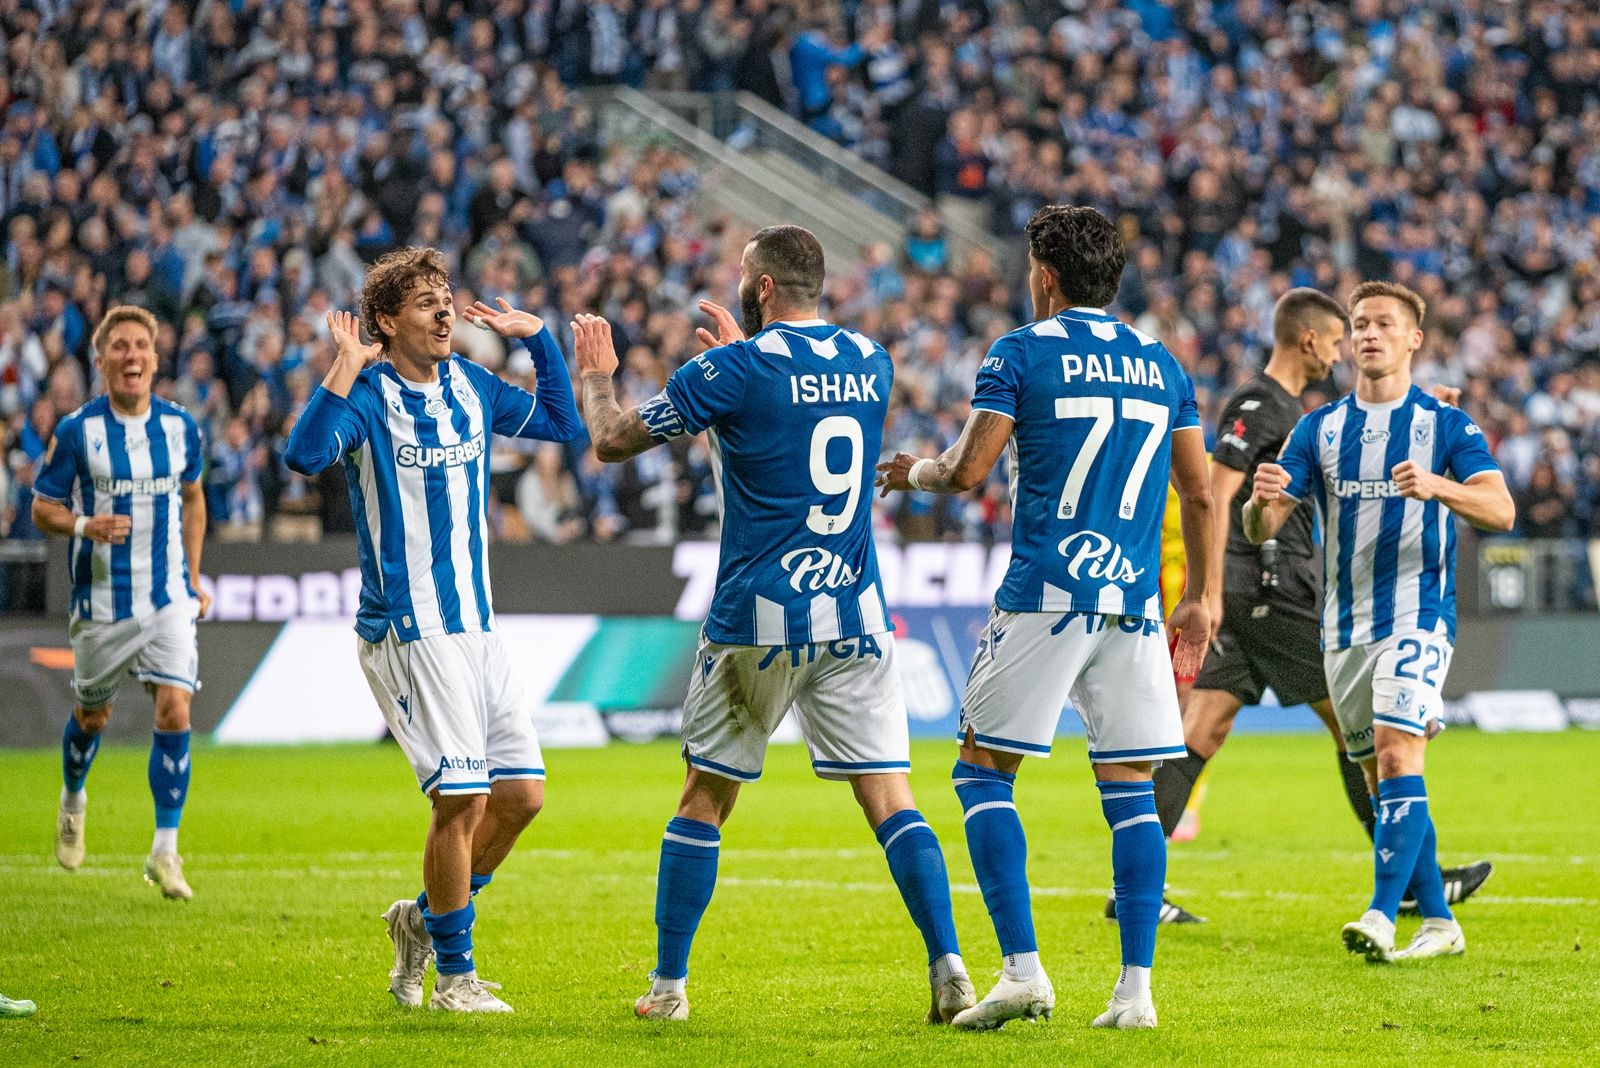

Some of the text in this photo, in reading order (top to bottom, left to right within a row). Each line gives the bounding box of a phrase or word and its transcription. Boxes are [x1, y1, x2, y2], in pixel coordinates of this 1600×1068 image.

[789, 373, 880, 404] ISHAK
[1060, 353, 1165, 390] PALMA
[805, 415, 864, 536] 9
[1054, 397, 1170, 521] 77
[95, 474, 178, 497] SUPERBE
[780, 546, 862, 593] Pils
[1057, 529, 1145, 584] Pils
[1394, 638, 1441, 688] 22
[440, 755, 486, 771] Arbton
